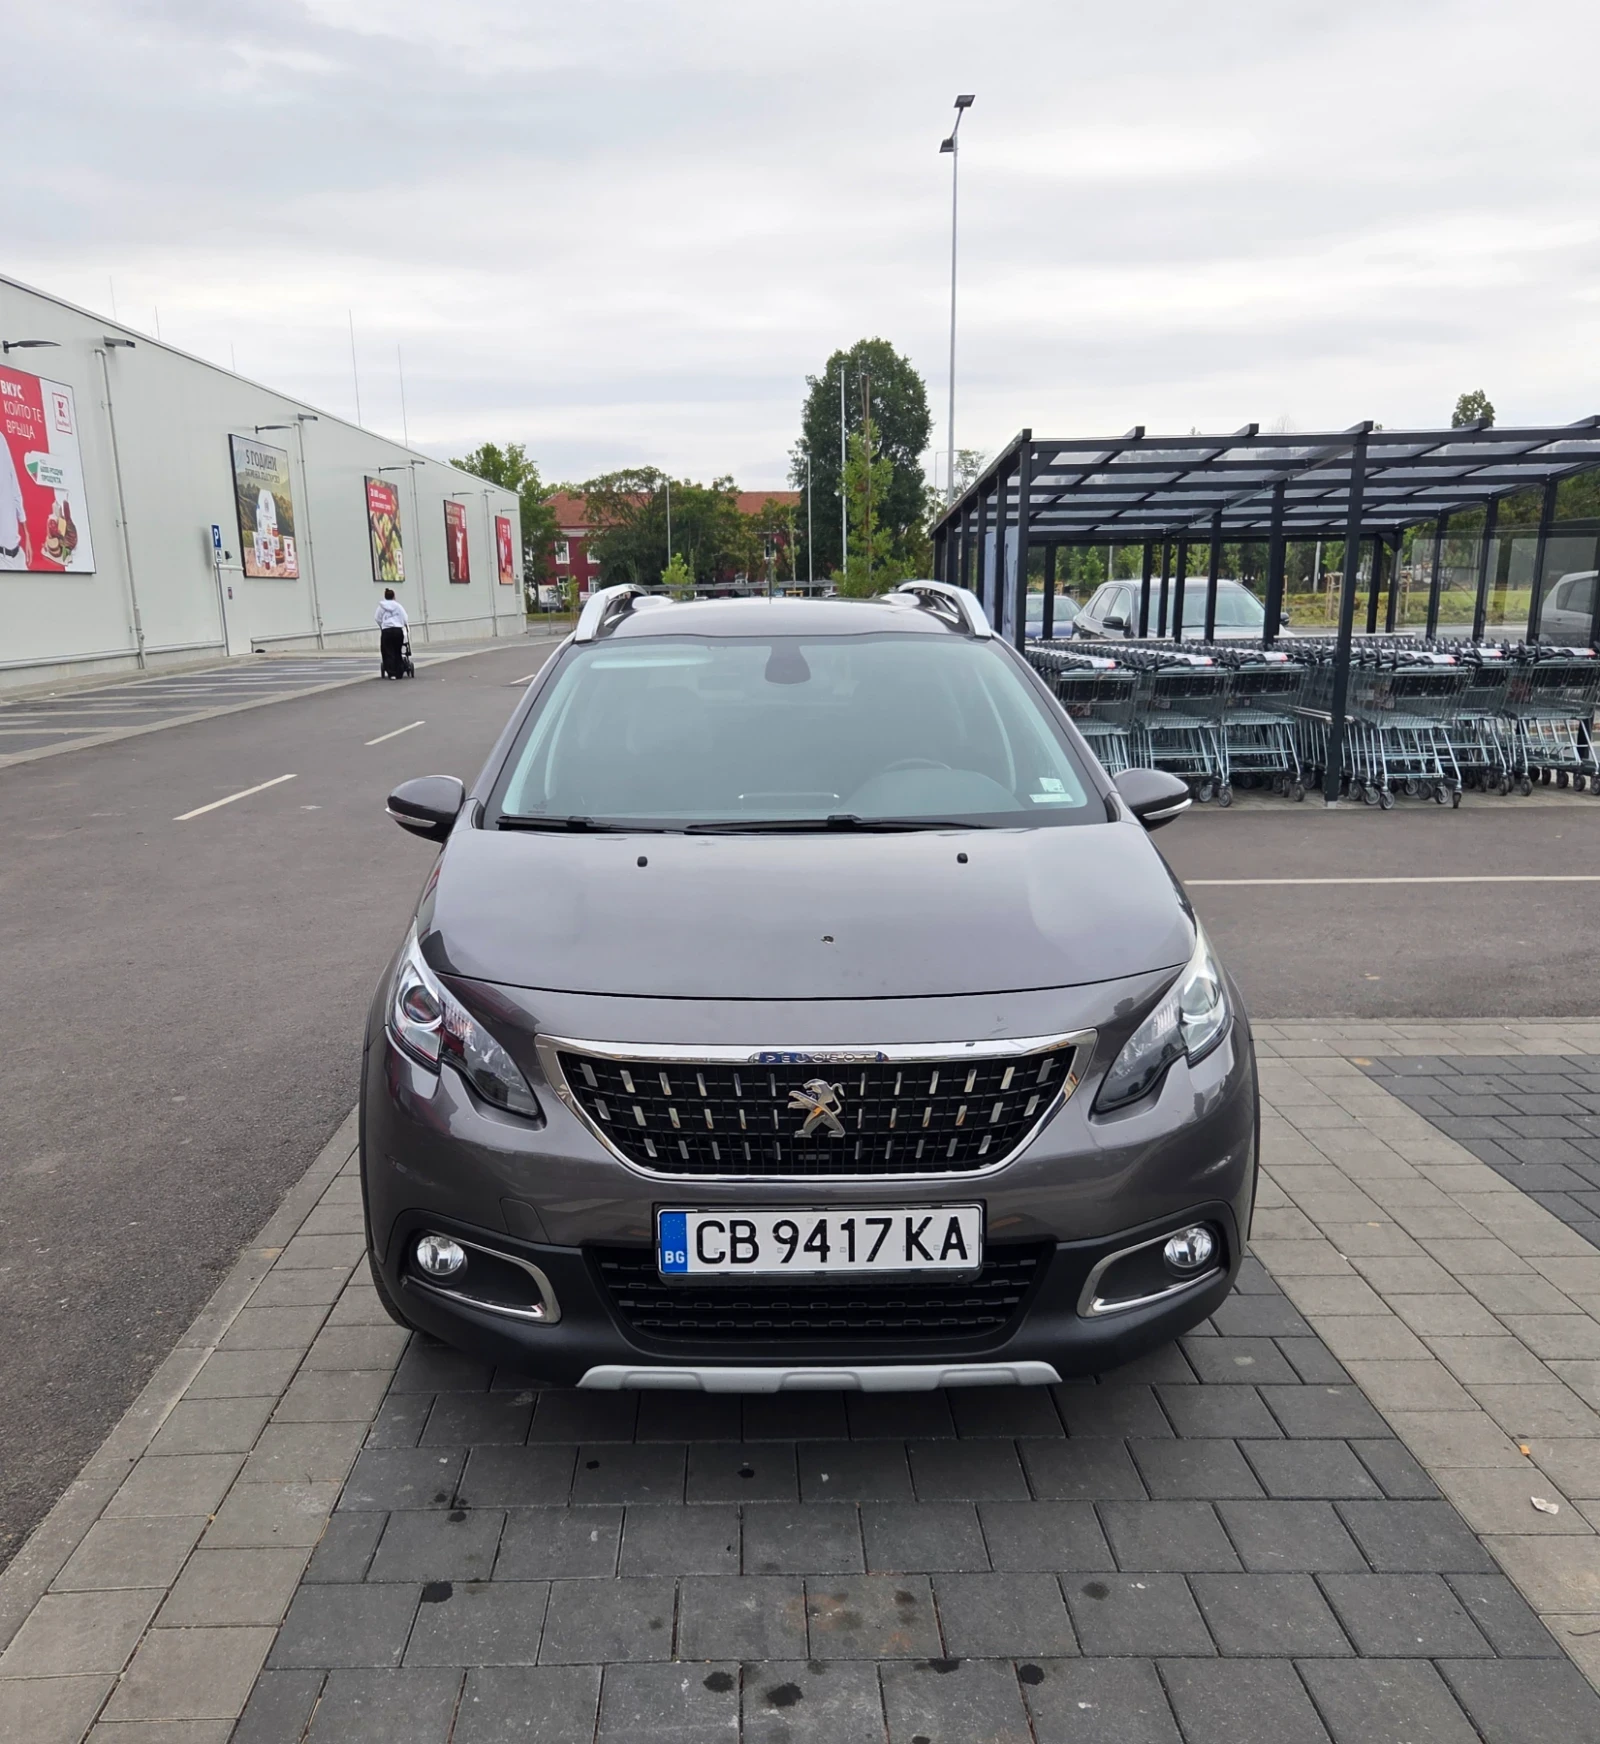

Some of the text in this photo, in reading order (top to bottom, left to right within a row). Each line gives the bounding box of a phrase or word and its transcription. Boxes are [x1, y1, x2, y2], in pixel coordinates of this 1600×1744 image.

[3, 399, 43, 423] КОЙТО ТЕ
[6, 419, 36, 440] ВРЪЩА
[213, 527, 219, 546] P
[696, 1215, 969, 1264] CB 9417 KA
[664, 1250, 686, 1264] BG
